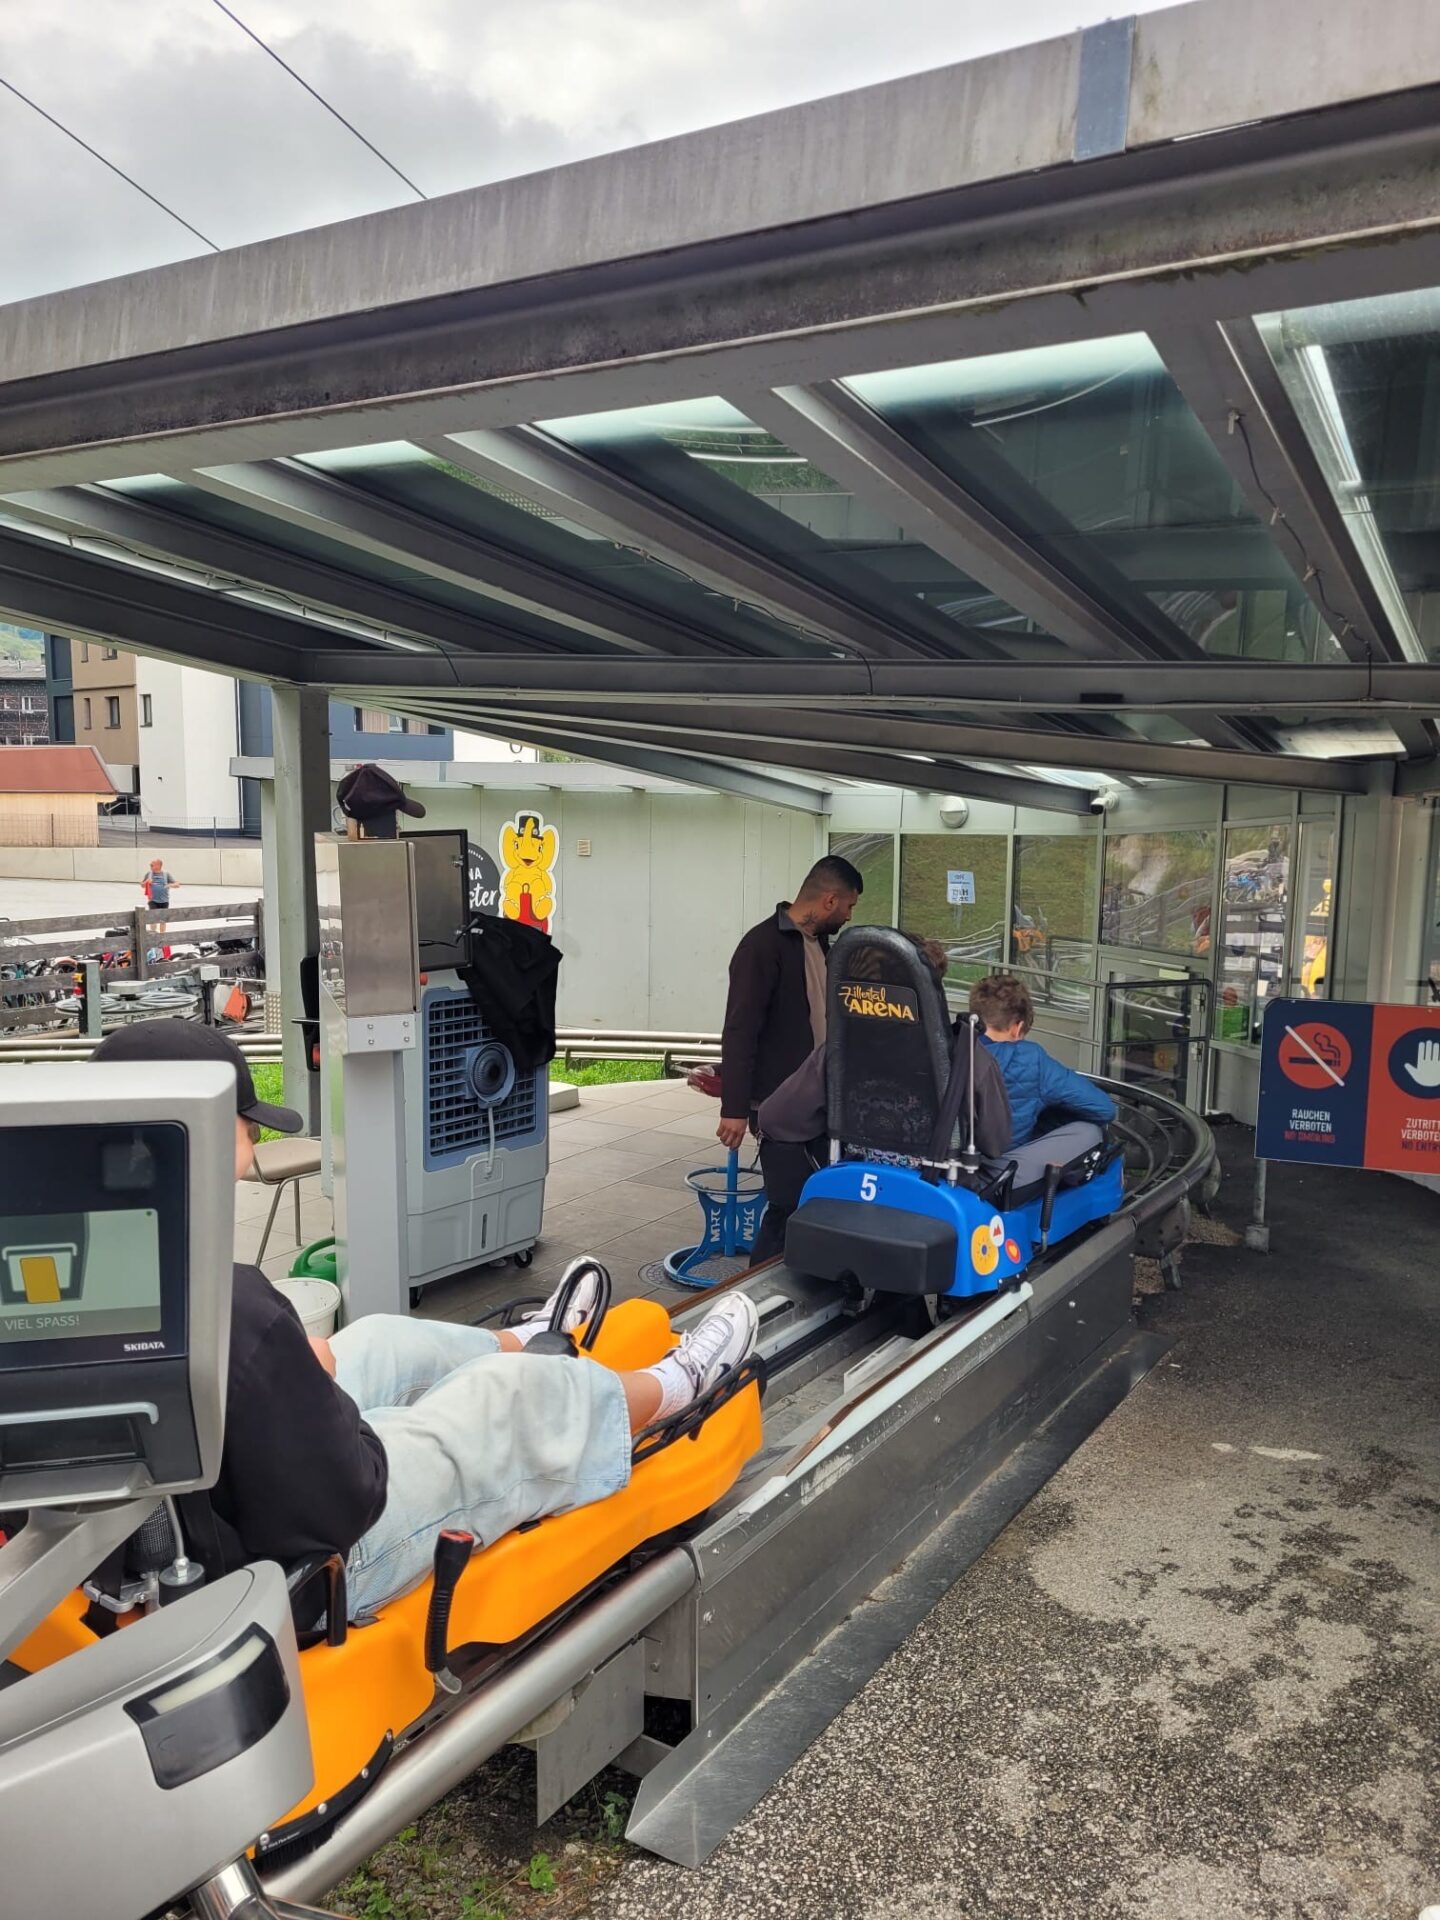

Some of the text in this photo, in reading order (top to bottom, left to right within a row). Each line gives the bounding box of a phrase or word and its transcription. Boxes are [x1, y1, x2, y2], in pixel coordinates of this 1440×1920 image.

[1292, 1109, 1330, 1121] RAUCHEN
[1290, 1120, 1332, 1133] VERBOTEN
[1401, 1129, 1440, 1141] VERBOTE
[860, 1173, 877, 1201] 5
[5, 1315, 80, 1331] VIEL SPASS!
[124, 1341, 165, 1352] SKIDATA
